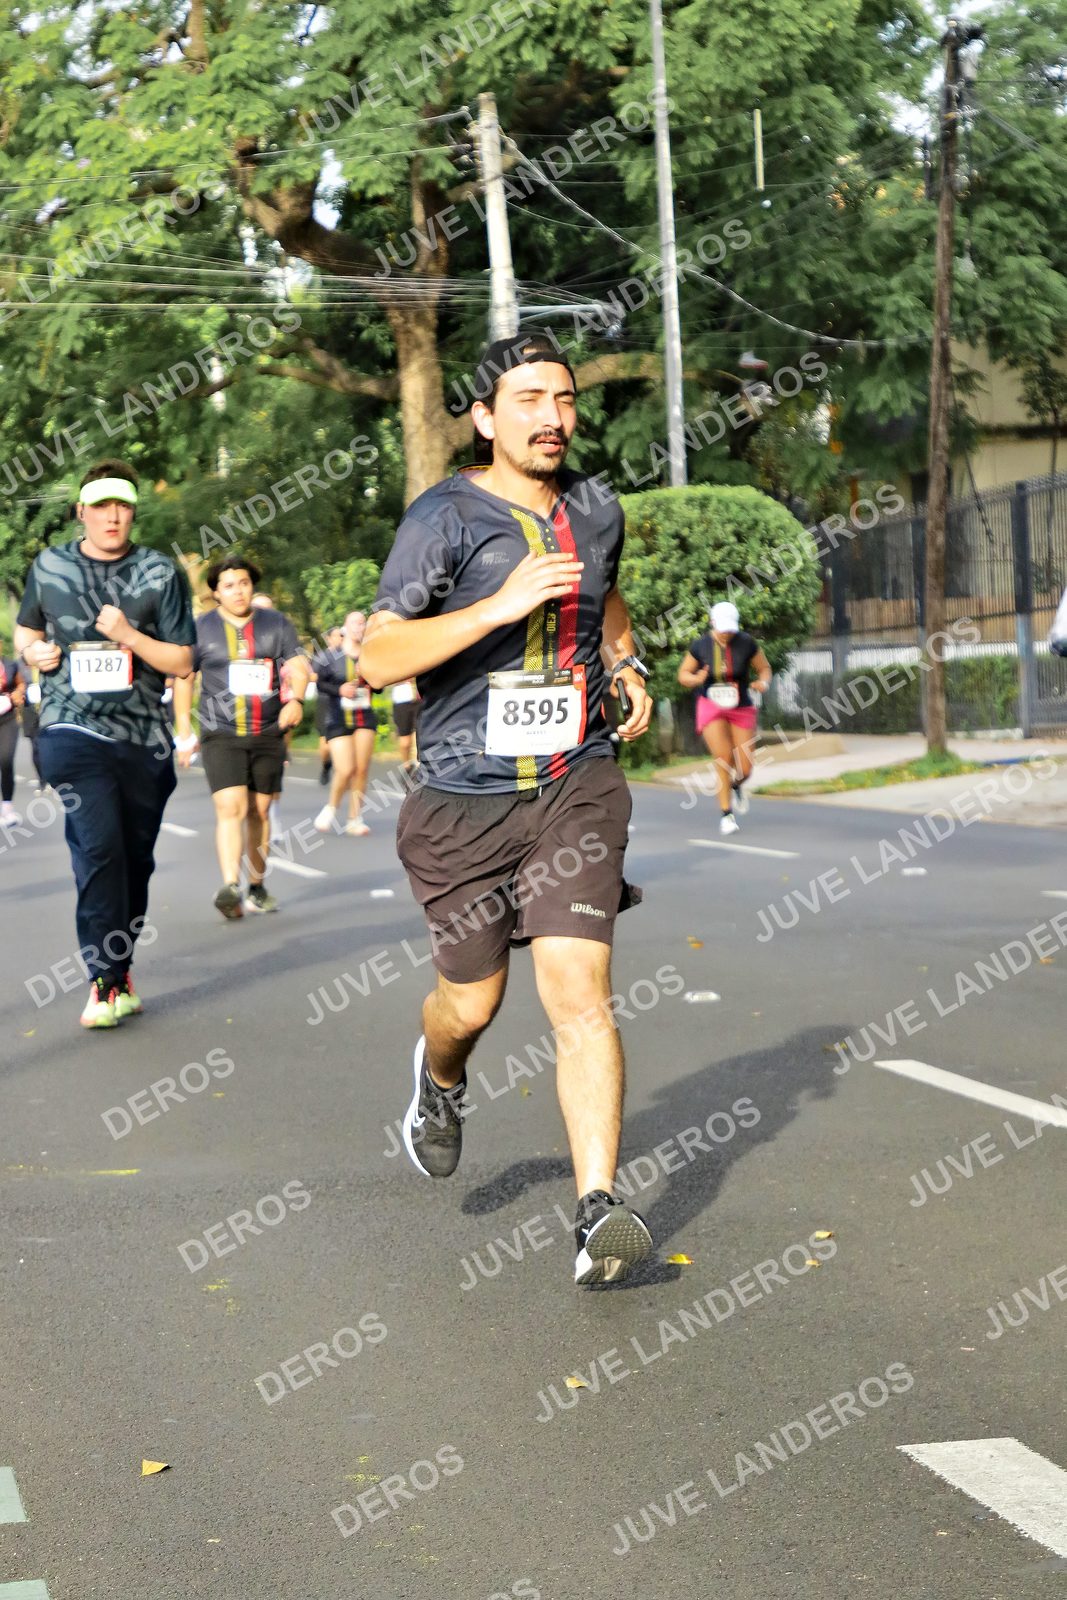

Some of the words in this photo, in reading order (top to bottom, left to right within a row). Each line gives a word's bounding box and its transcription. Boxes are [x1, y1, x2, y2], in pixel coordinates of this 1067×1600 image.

[76, 657, 123, 673] 11287
[502, 697, 569, 726] 8595
[570, 902, 606, 918] Wilson
